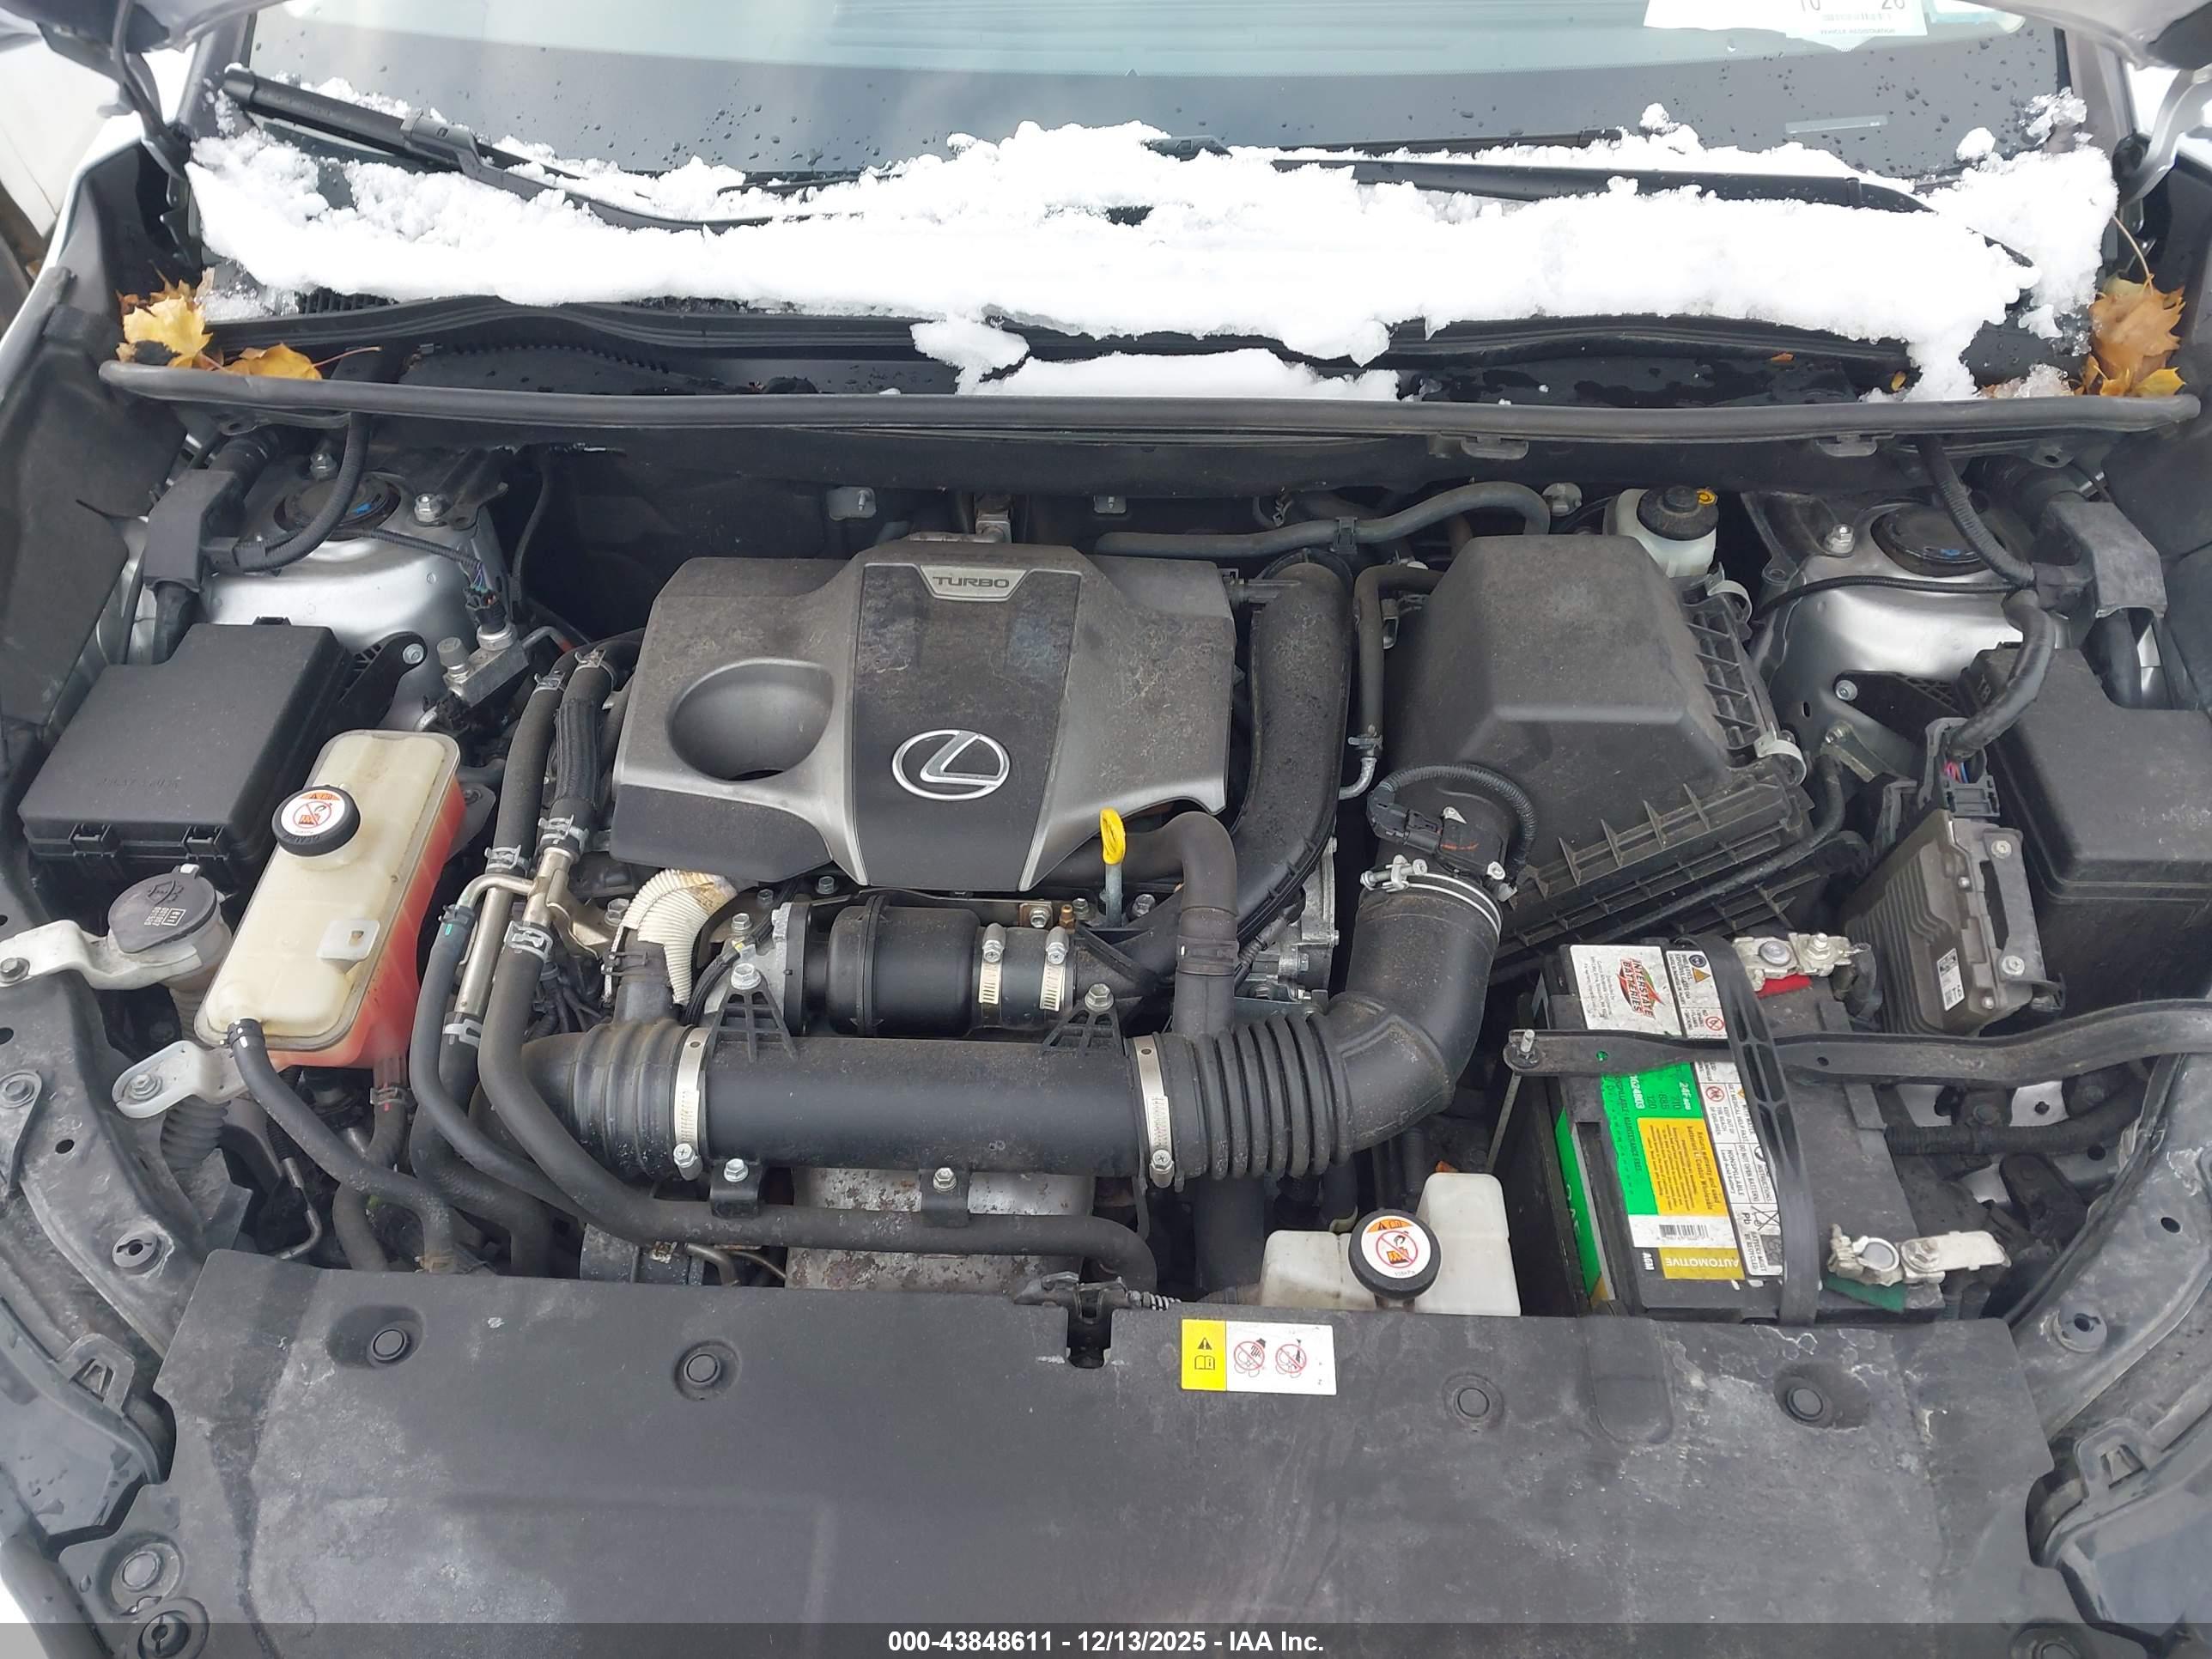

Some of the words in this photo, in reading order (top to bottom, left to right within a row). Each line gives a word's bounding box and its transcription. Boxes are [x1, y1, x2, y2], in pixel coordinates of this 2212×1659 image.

[933, 576, 1010, 588] TURBO
[1621, 961, 1643, 1012] BATTERIES
[1631, 960, 1655, 1017] INTERSTATE
[1678, 1082, 1692, 1097] 24F
[1645, 1096, 1657, 1109] 120
[1726, 1149, 1745, 1195] NONSPILLABLE
[1743, 1163, 1753, 1176] OPEN
[1756, 1164, 1772, 1201] INSTRUCTIONS
[1741, 1212, 1753, 1224] Pb
[1750, 1231, 1762, 1254] BATTERY
[1642, 1252, 1655, 1271] AGM
[1666, 1257, 1740, 1268] AUTOMOTIVE
